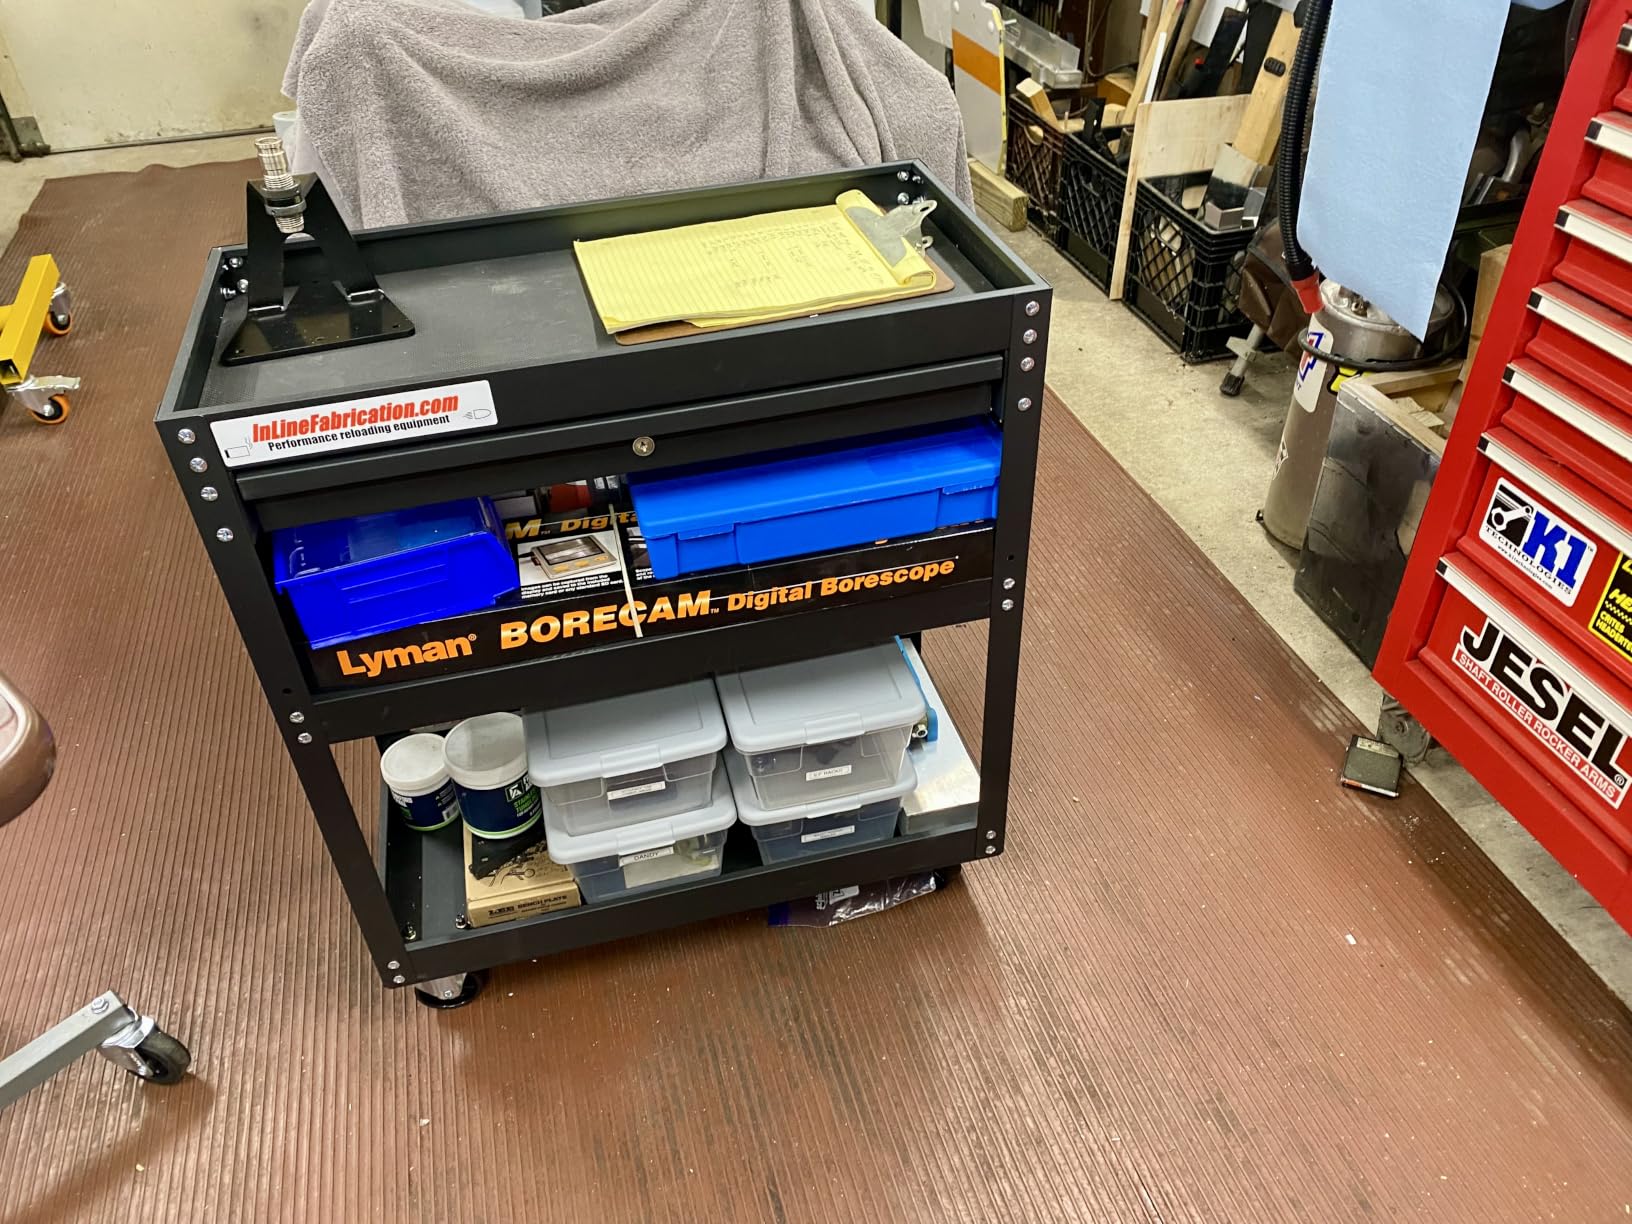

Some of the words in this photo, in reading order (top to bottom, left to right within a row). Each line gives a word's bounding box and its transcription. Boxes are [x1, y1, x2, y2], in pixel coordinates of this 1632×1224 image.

[252, 395, 459, 443] InLineFabrication.com
[267, 432, 338, 452] Performance
[340, 420, 392, 441] reloading
[394, 414, 451, 434] equipment
[1485, 524, 1572, 595] TECHNOLOGIES
[727, 582, 812, 611] Digital
[820, 561, 955, 597] Borescope
[1600, 611, 1625, 634] CRITES
[1459, 653, 1494, 687] SHAFT
[1491, 683, 1533, 725] ROLLER
[1533, 719, 1582, 768] ROCKER
[1580, 763, 1616, 799] ARMS
